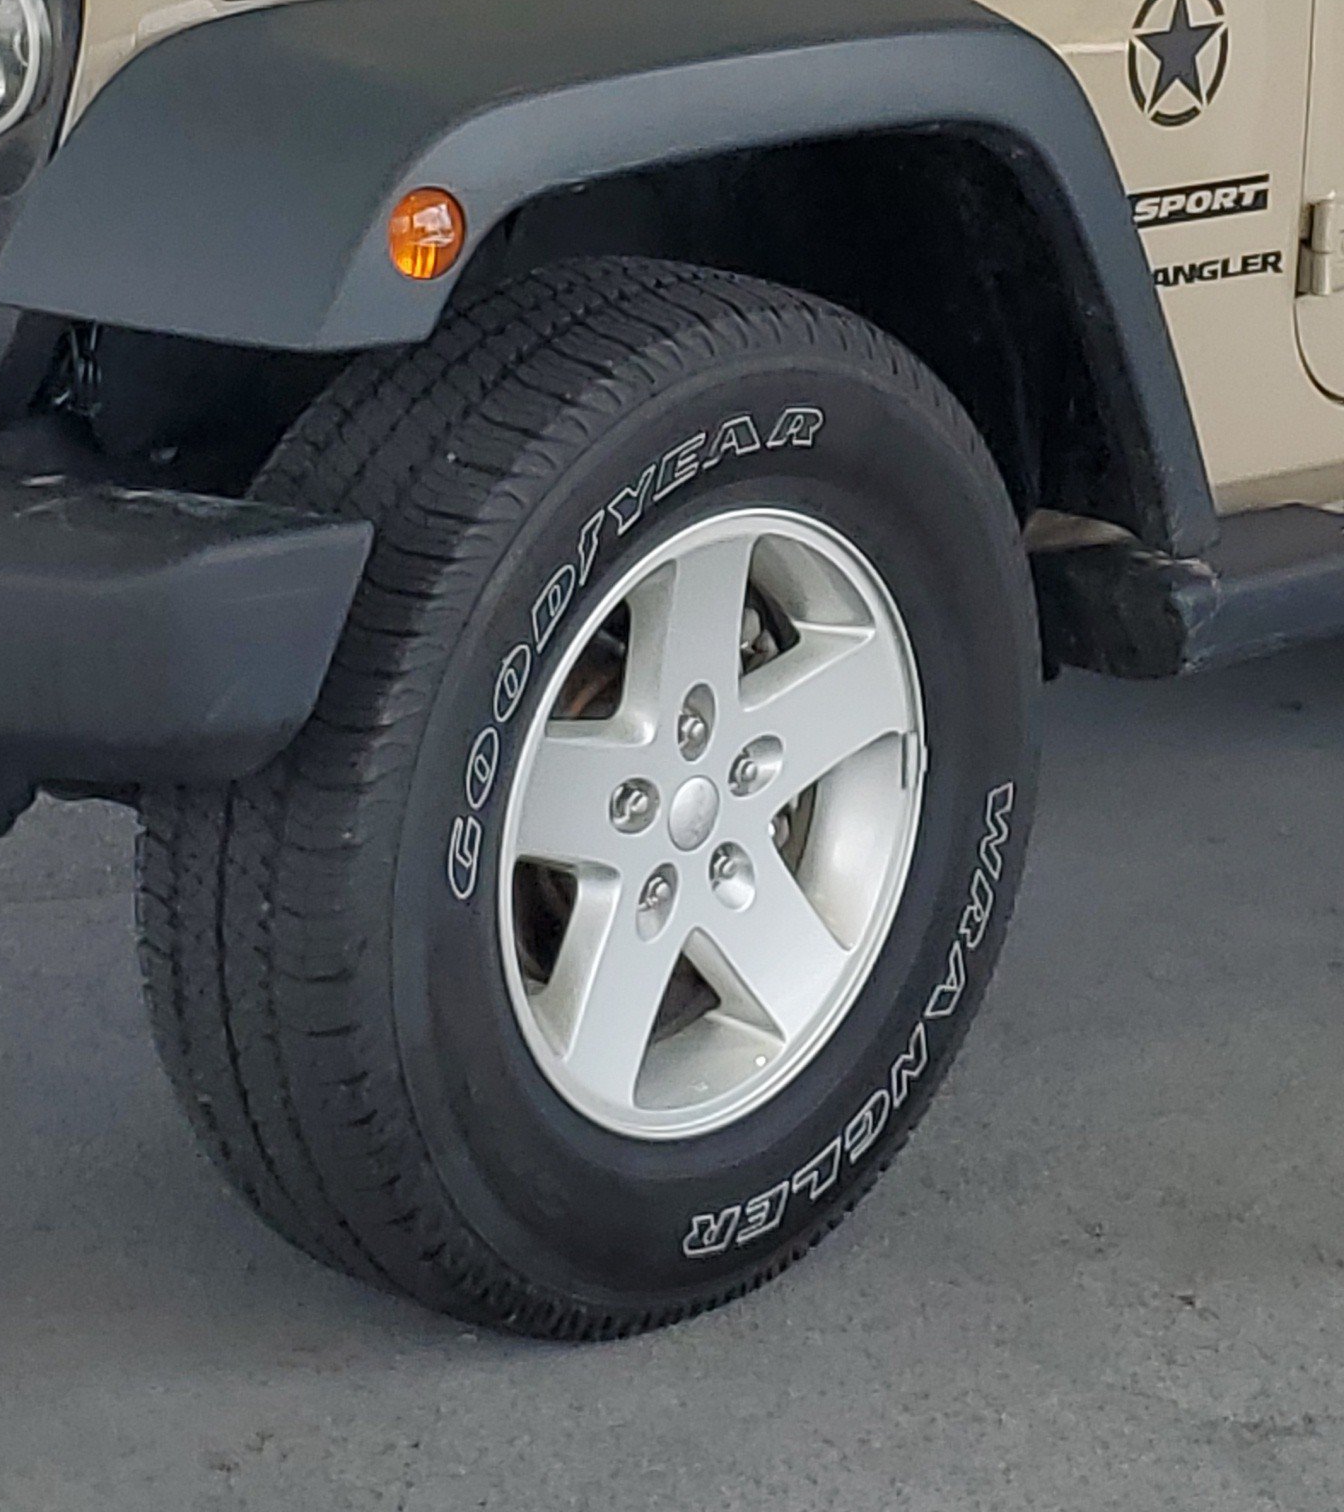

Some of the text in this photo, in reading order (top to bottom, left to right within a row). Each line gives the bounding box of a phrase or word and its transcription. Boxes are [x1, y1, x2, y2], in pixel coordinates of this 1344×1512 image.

[1133, 181, 1269, 222] SPORT
[1154, 250, 1283, 287] ANGLER
[449, 407, 824, 900] GOODYEAR
[683, 782, 1015, 1261] WRANGLER
